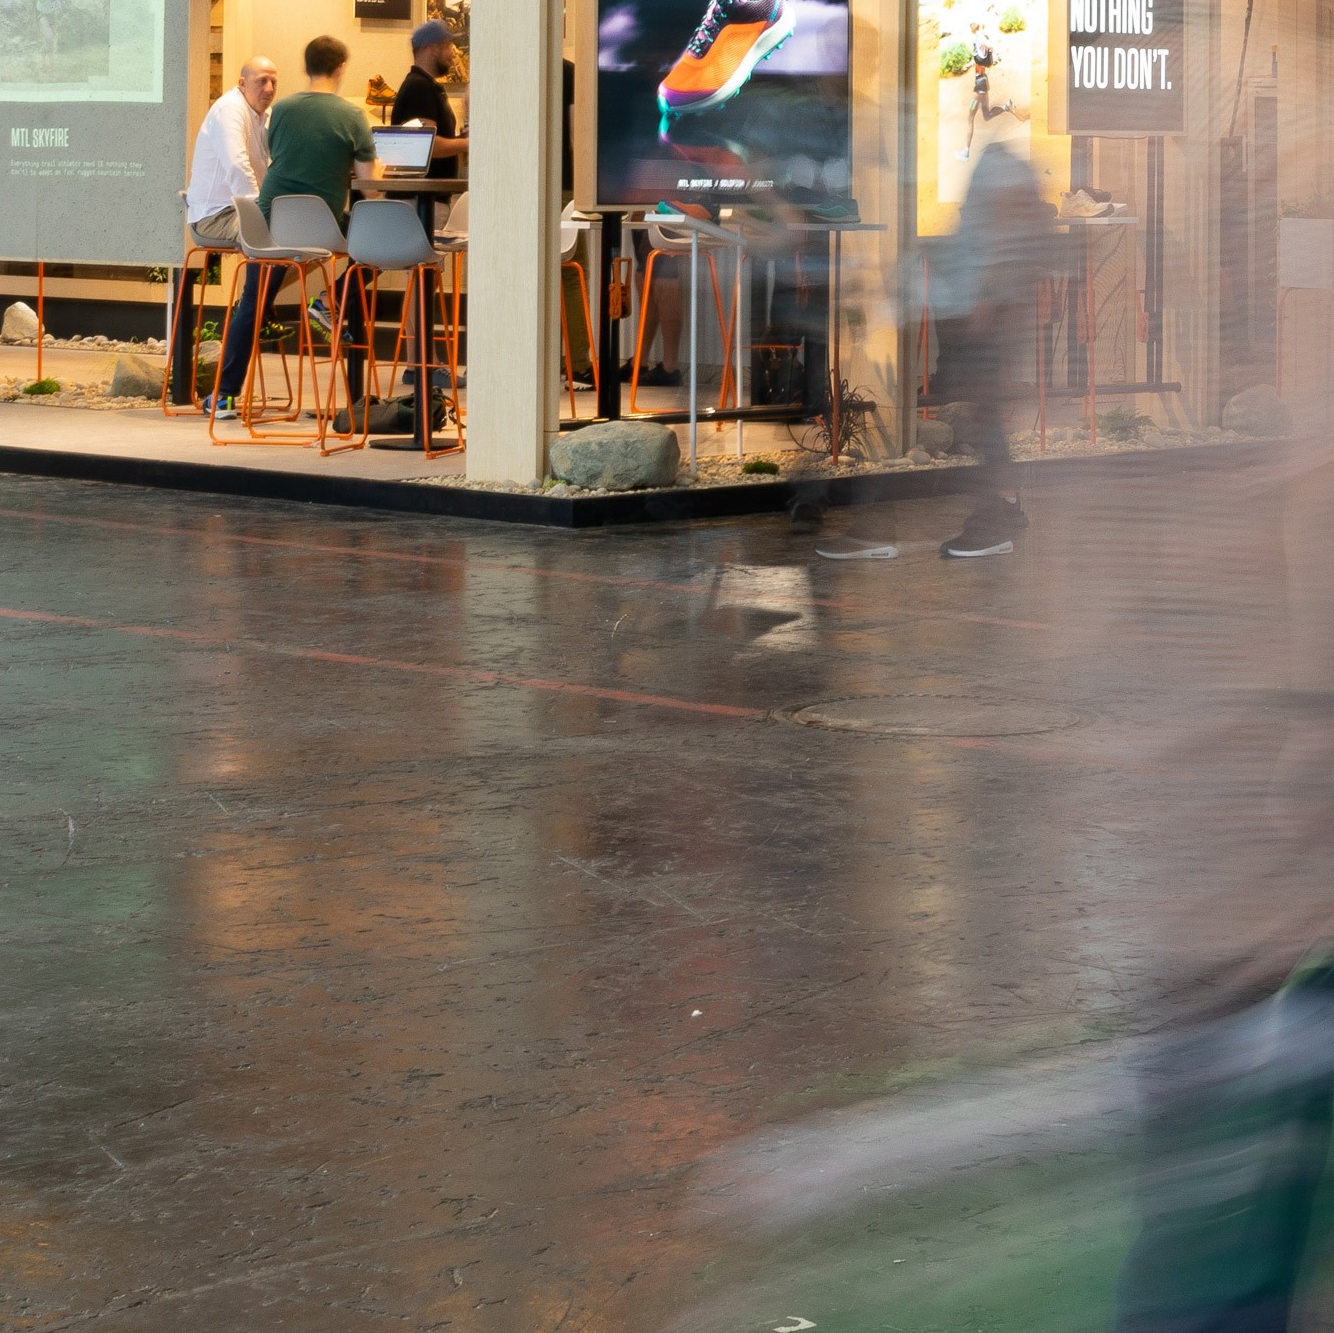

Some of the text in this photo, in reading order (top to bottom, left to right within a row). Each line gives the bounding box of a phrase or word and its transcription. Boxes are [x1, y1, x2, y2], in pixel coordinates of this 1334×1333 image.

[1071, 45, 1172, 90] YOU DON'T.
[11, 127, 70, 148] MTL SKYFIRE
